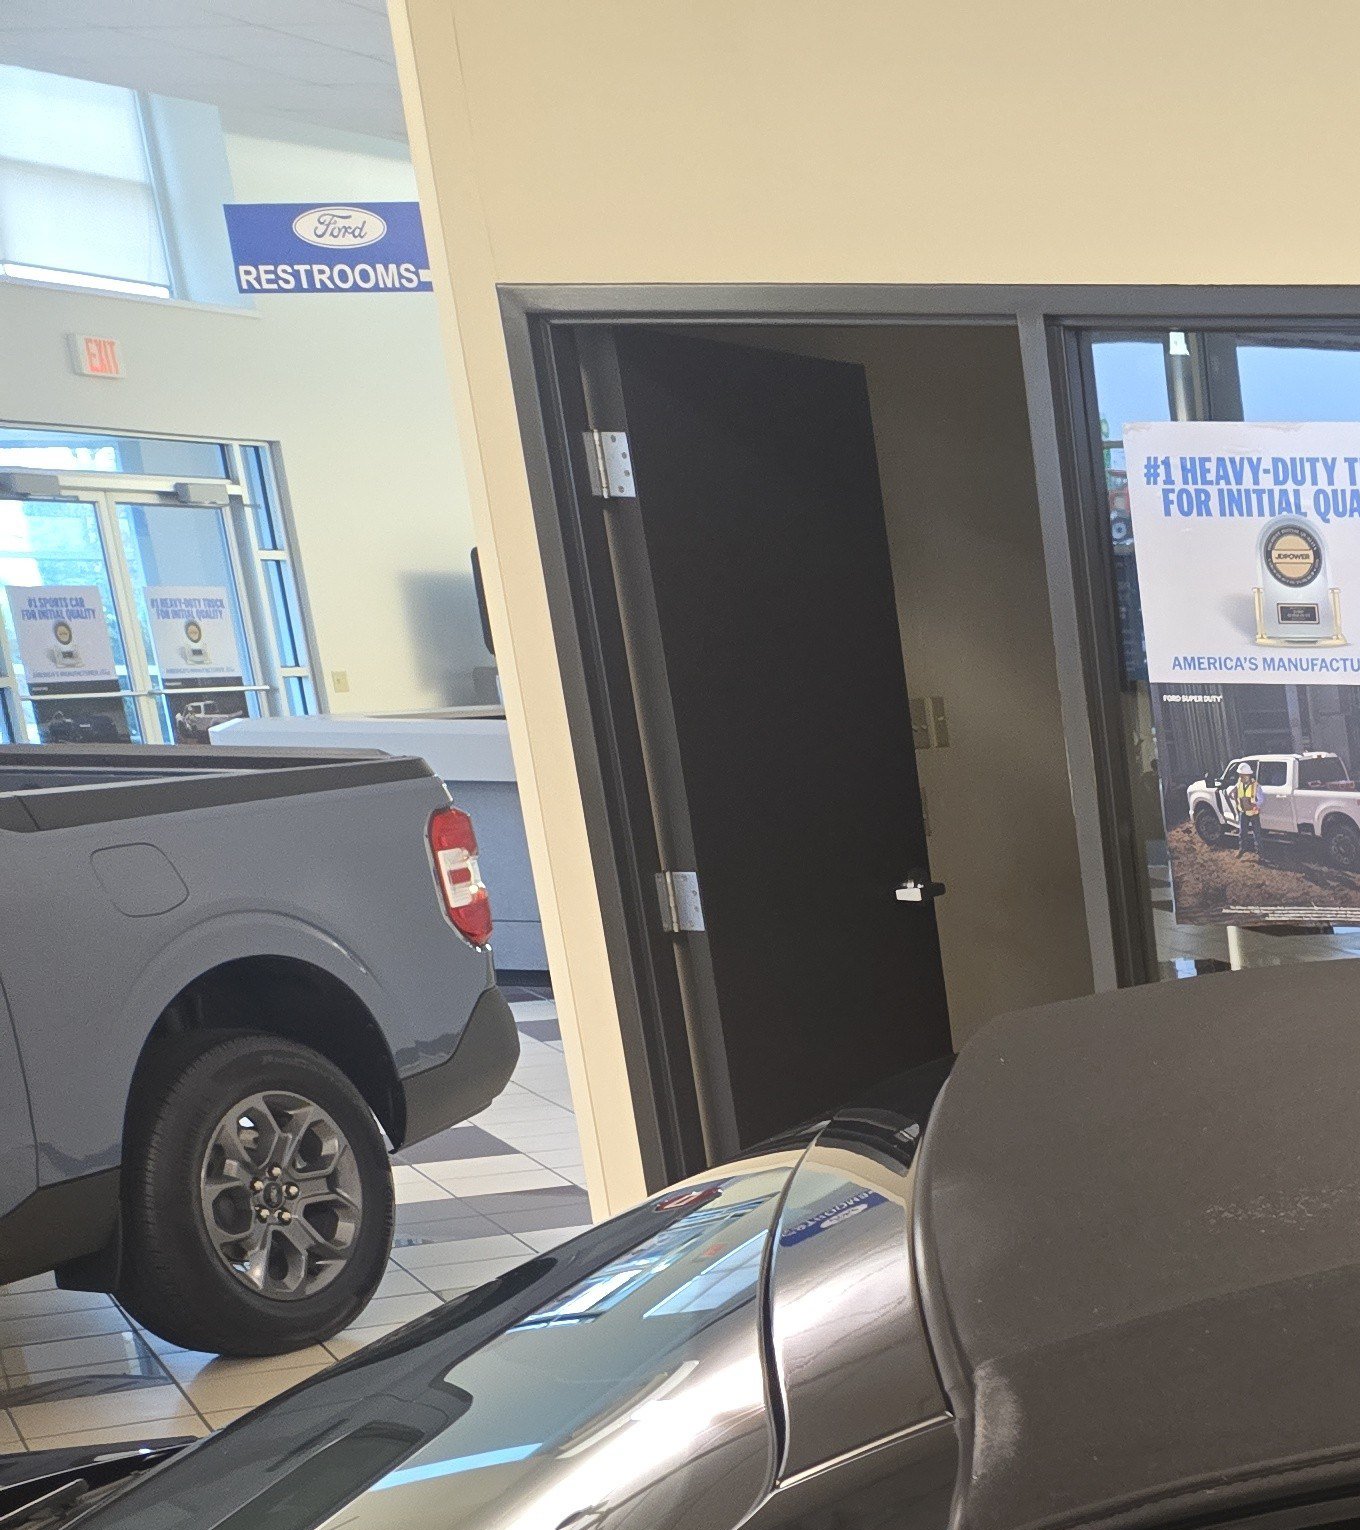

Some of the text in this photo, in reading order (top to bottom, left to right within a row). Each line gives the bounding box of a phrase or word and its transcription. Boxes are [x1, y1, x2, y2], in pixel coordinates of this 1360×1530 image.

[313, 212, 368, 240] Ford
[238, 263, 419, 290] RESTROOMS
[85, 337, 119, 375] EXIT
[1144, 456, 1175, 486] #1
[1180, 456, 1337, 487] HEAVY-DUTY
[1162, 488, 1213, 517] FOR
[1218, 488, 1307, 517] INITIAL
[1172, 656, 1258, 671] AMERICA'S
